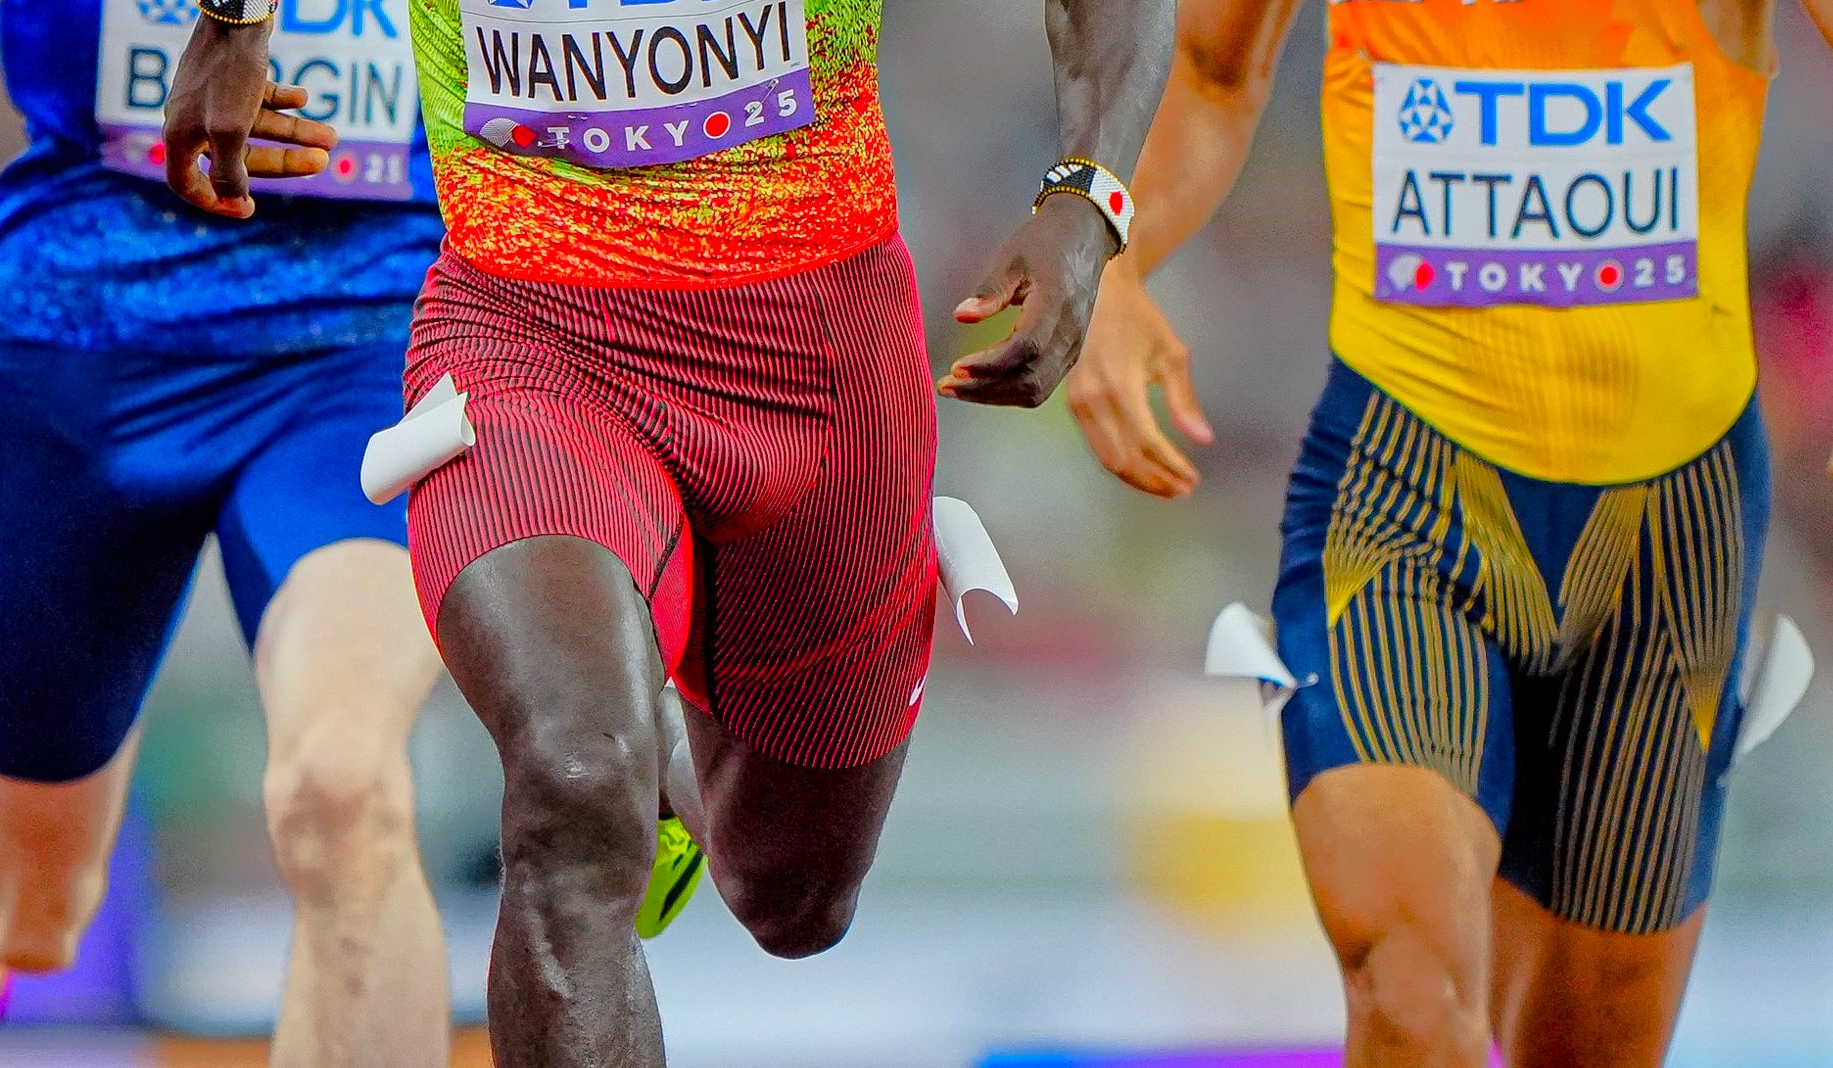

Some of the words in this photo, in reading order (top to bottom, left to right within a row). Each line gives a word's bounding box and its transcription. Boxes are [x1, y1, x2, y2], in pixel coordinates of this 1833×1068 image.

[128, 49, 402, 125] BGIN
[475, 1, 792, 103] WANYONYI
[1455, 79, 1673, 146] TDK
[1393, 167, 1680, 241] ATTAOUI
